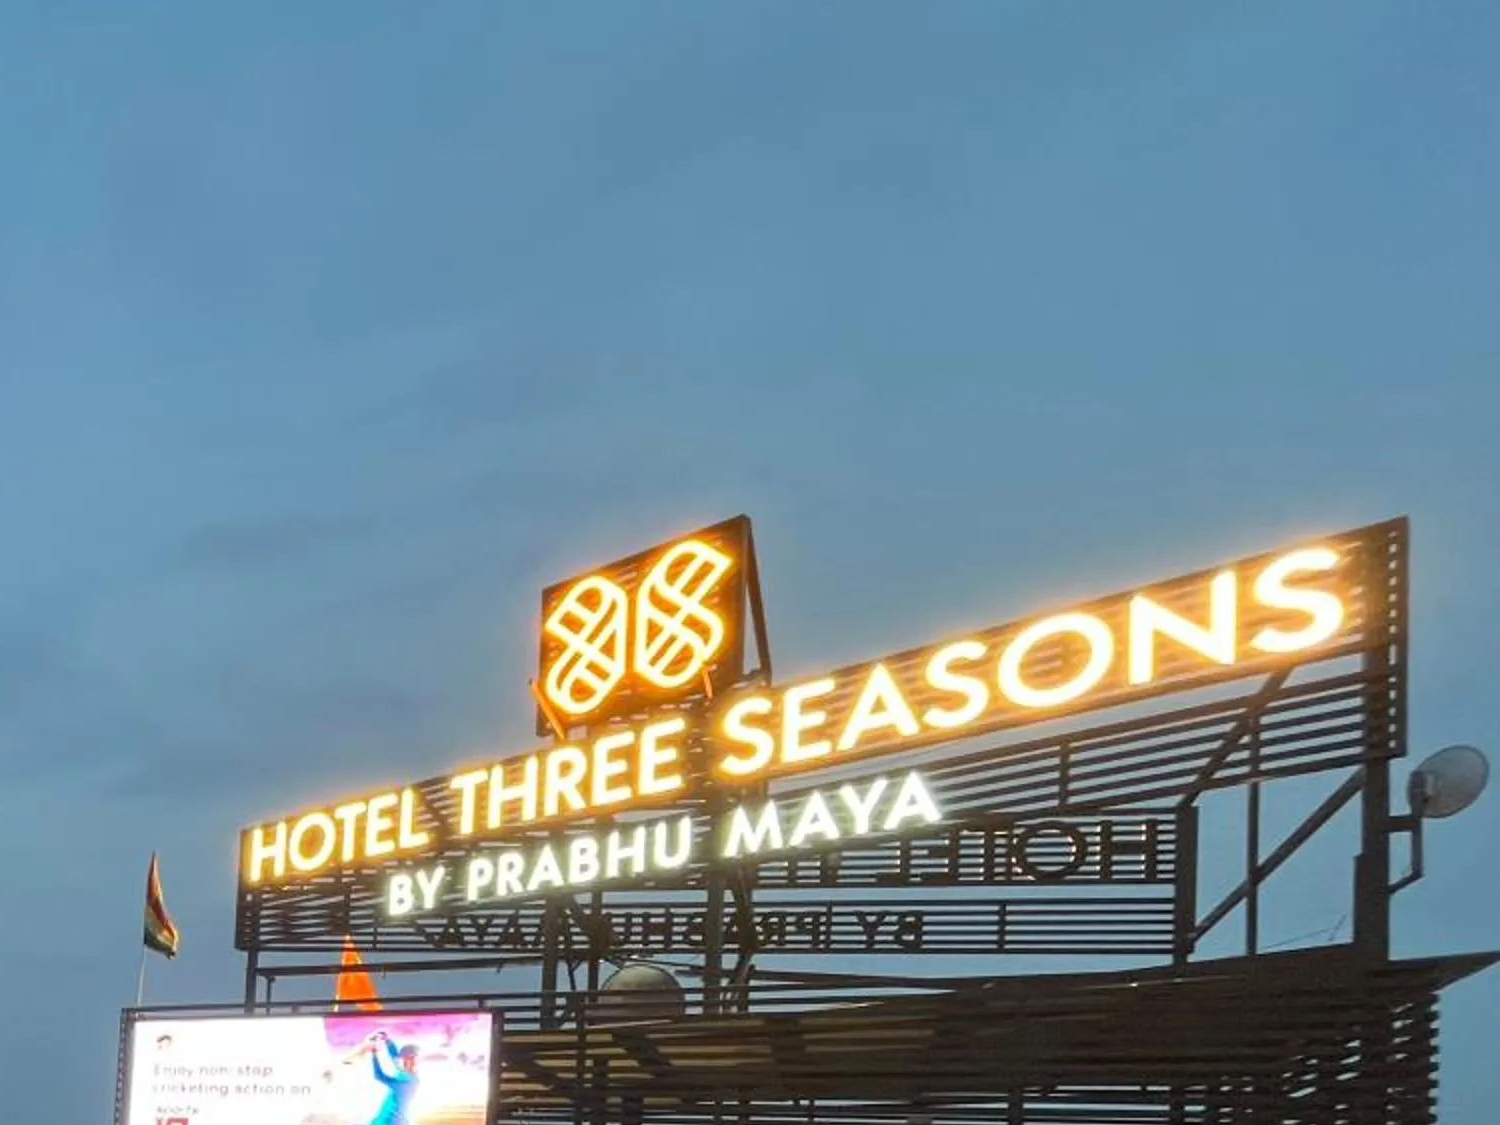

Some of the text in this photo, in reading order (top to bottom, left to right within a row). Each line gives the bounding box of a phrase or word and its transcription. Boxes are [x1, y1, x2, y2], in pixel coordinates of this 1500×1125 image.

[248, 547, 1345, 883] HOTEL THREE SEASONS
[386, 866, 446, 917] BY
[466, 815, 694, 902] PRABHU
[723, 771, 943, 858] MAYA
[234, 1084, 285, 1097] action
[289, 1085, 312, 1096] on
